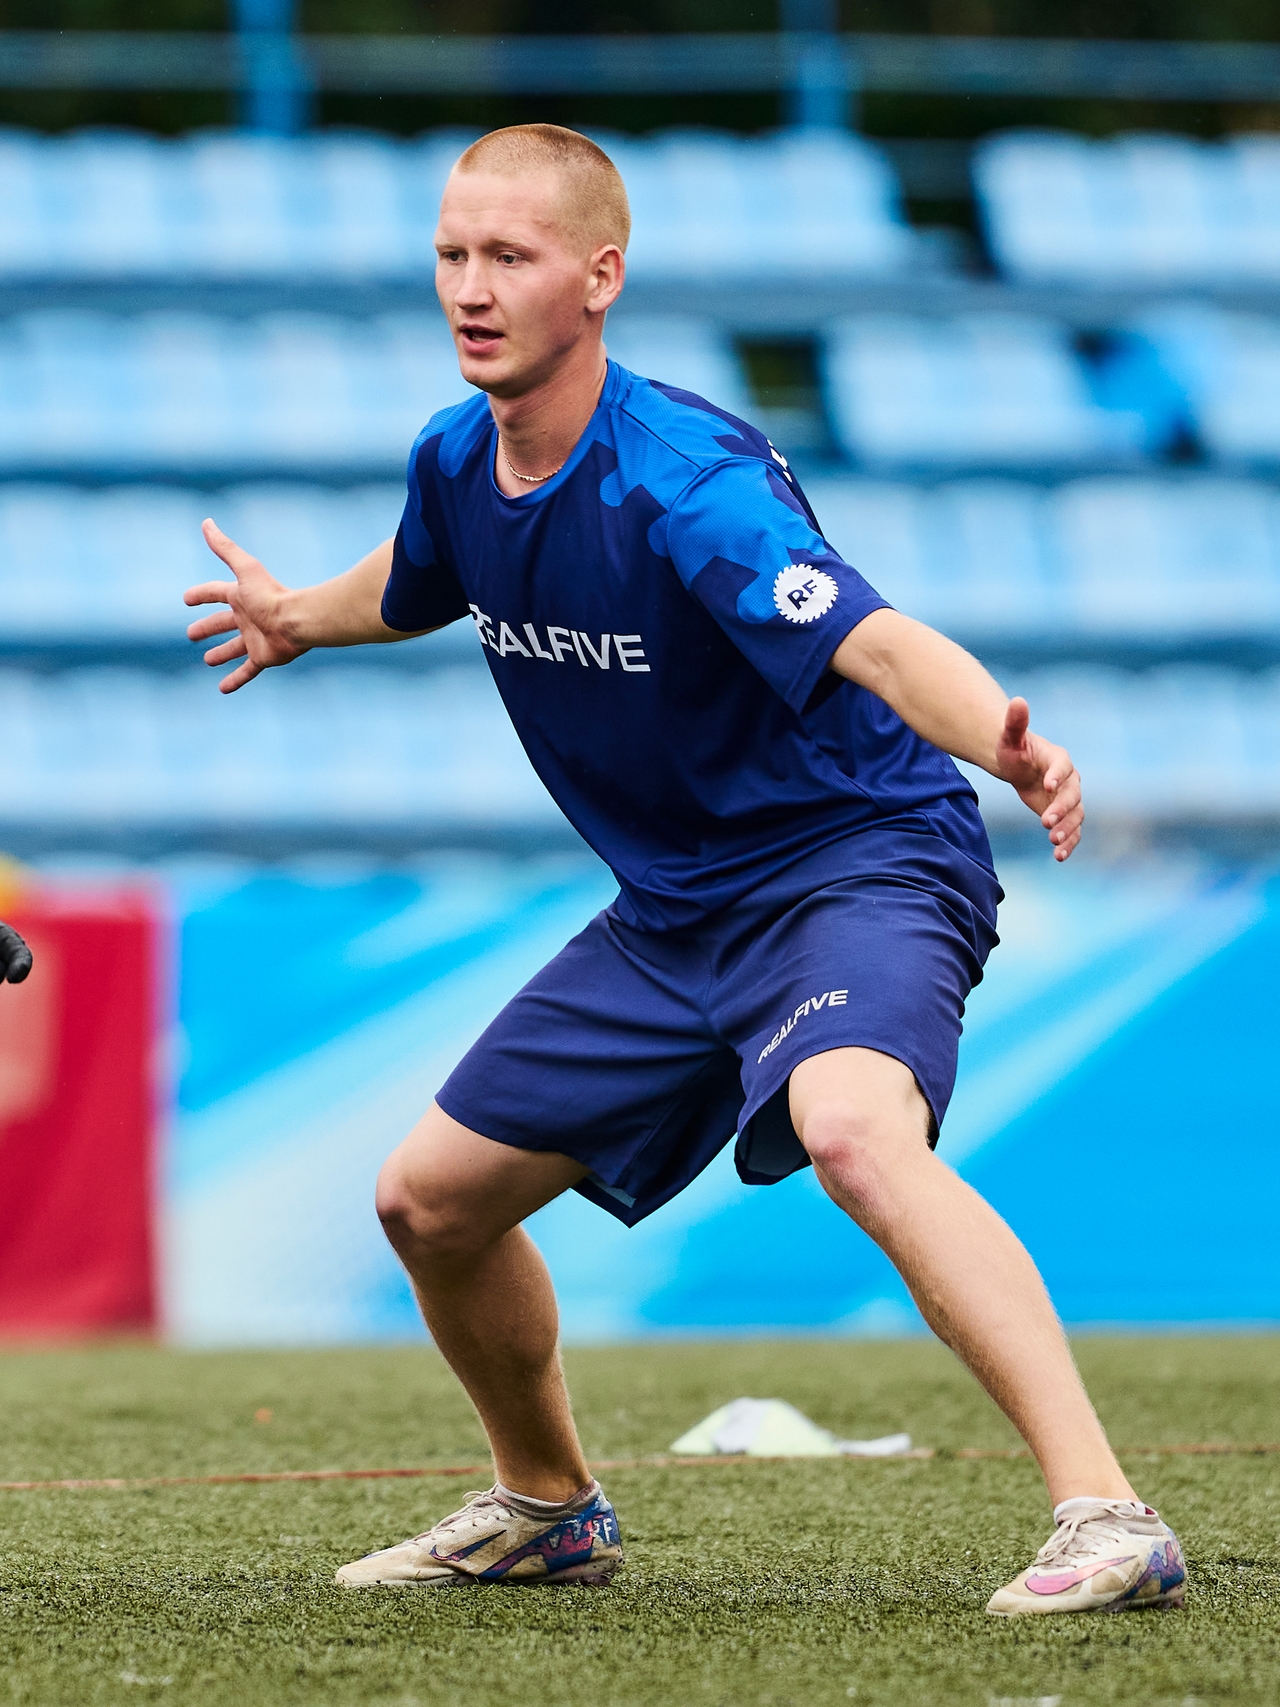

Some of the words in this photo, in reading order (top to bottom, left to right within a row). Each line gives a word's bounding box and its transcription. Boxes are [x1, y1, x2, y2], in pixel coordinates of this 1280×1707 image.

[786, 578, 818, 611] RF
[467, 602, 651, 673] REALFIVE
[757, 989, 849, 1065] REALFIVE
